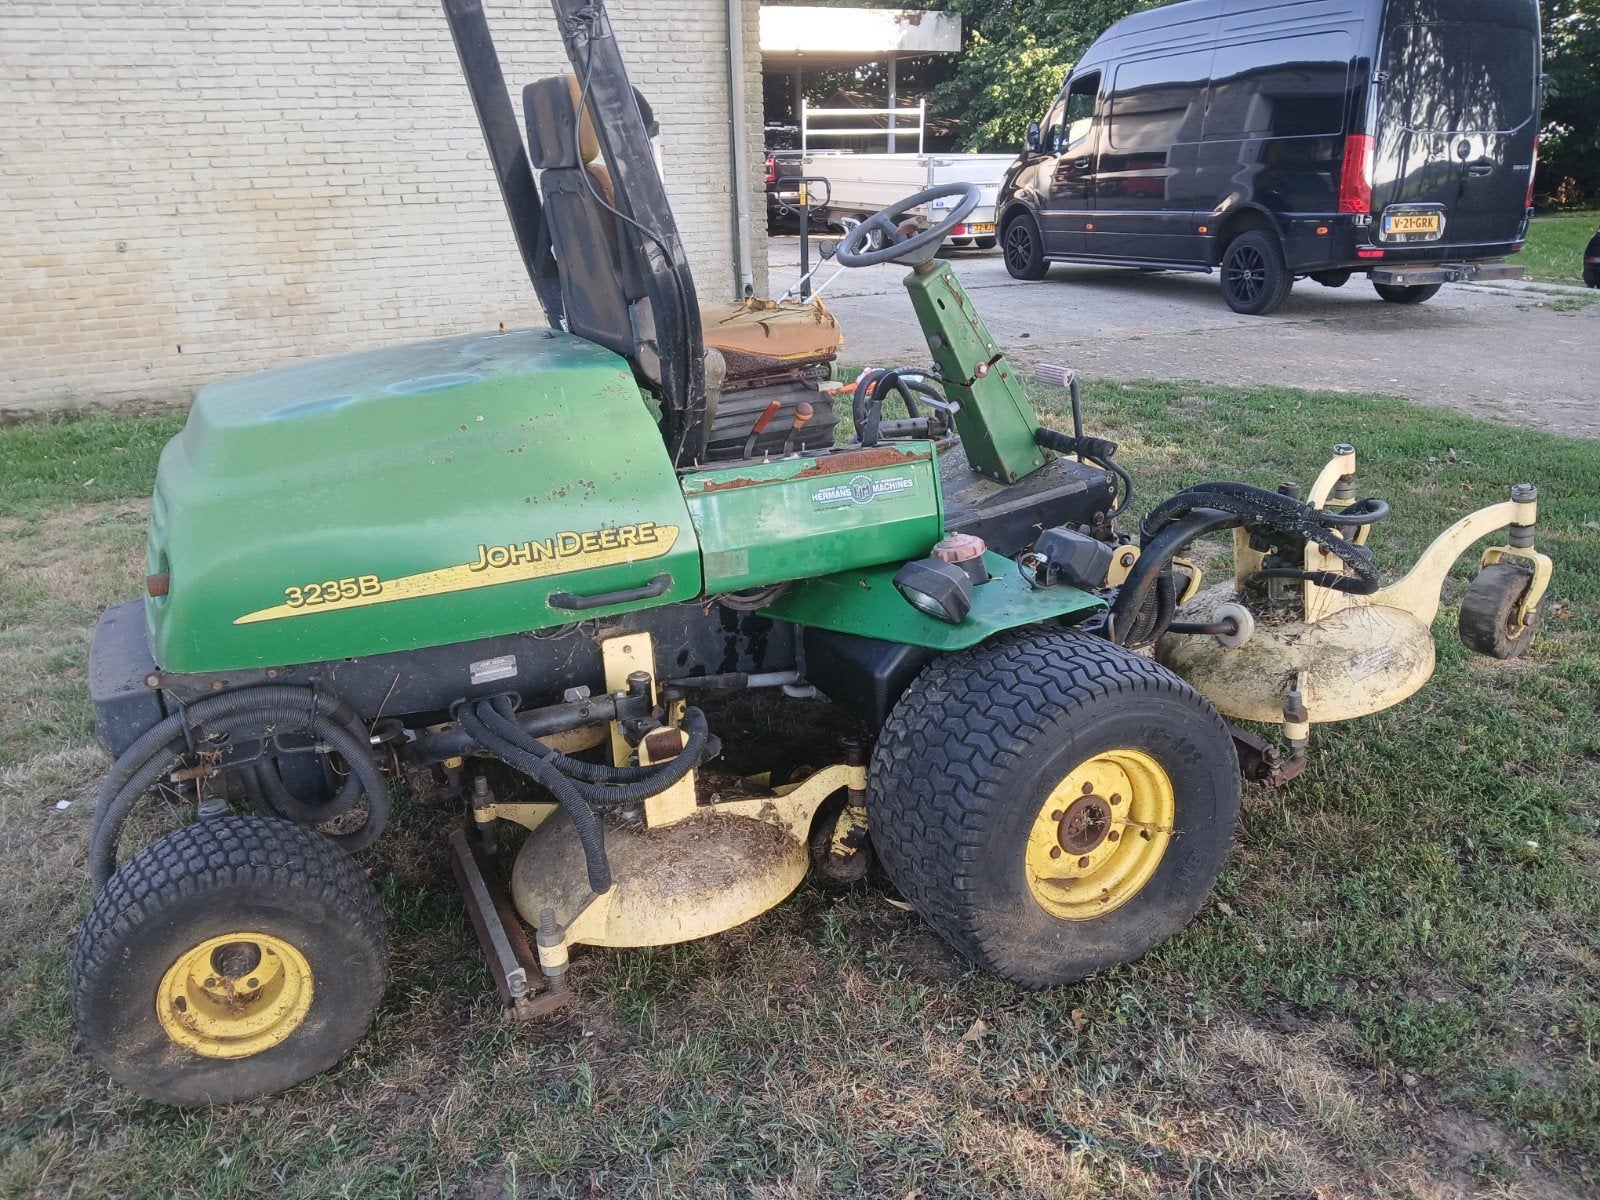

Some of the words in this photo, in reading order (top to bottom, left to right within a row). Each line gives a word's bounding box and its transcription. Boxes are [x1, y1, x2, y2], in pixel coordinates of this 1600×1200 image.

[1394, 217, 1434, 229] V-21-GRK
[811, 488, 852, 502] HERMANS
[872, 479, 913, 493] MACHINES
[469, 537, 557, 571] JOHN
[557, 522, 659, 555] DEERE
[284, 574, 383, 608] 3235B
